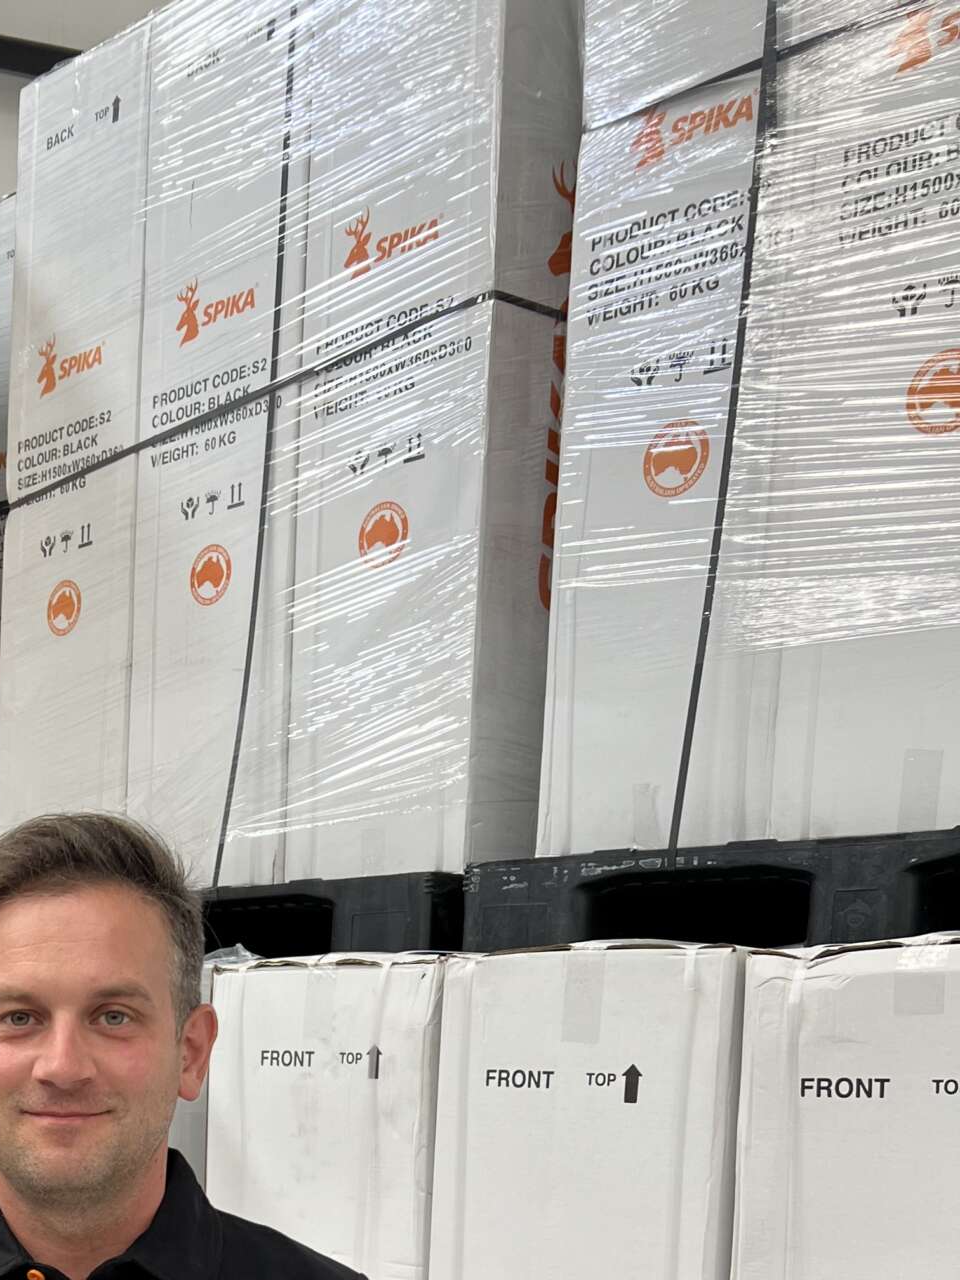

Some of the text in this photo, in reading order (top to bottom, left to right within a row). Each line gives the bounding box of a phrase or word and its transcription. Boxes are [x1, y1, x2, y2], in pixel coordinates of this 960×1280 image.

[46, 107, 110, 151] BACK TOP
[670, 95, 753, 146] SPIKA
[6, 249, 16, 260] TO
[373, 218, 440, 263] SPIKA
[201, 287, 256, 327] SPIKA
[58, 345, 102, 381] SPIKA
[152, 377, 209, 410] PRODUCT
[152, 383, 252, 429] COLOUR: BLACK
[17, 427, 65, 455] PRODUCT
[17, 433, 99, 472] COLOUR: BLACK
[150, 442, 199, 469] WEIGHT:
[260, 1050, 363, 1067] FRONT TOP
[486, 1069, 617, 1088] FRONT TOP
[800, 1077, 959, 1099] FRONT TO
